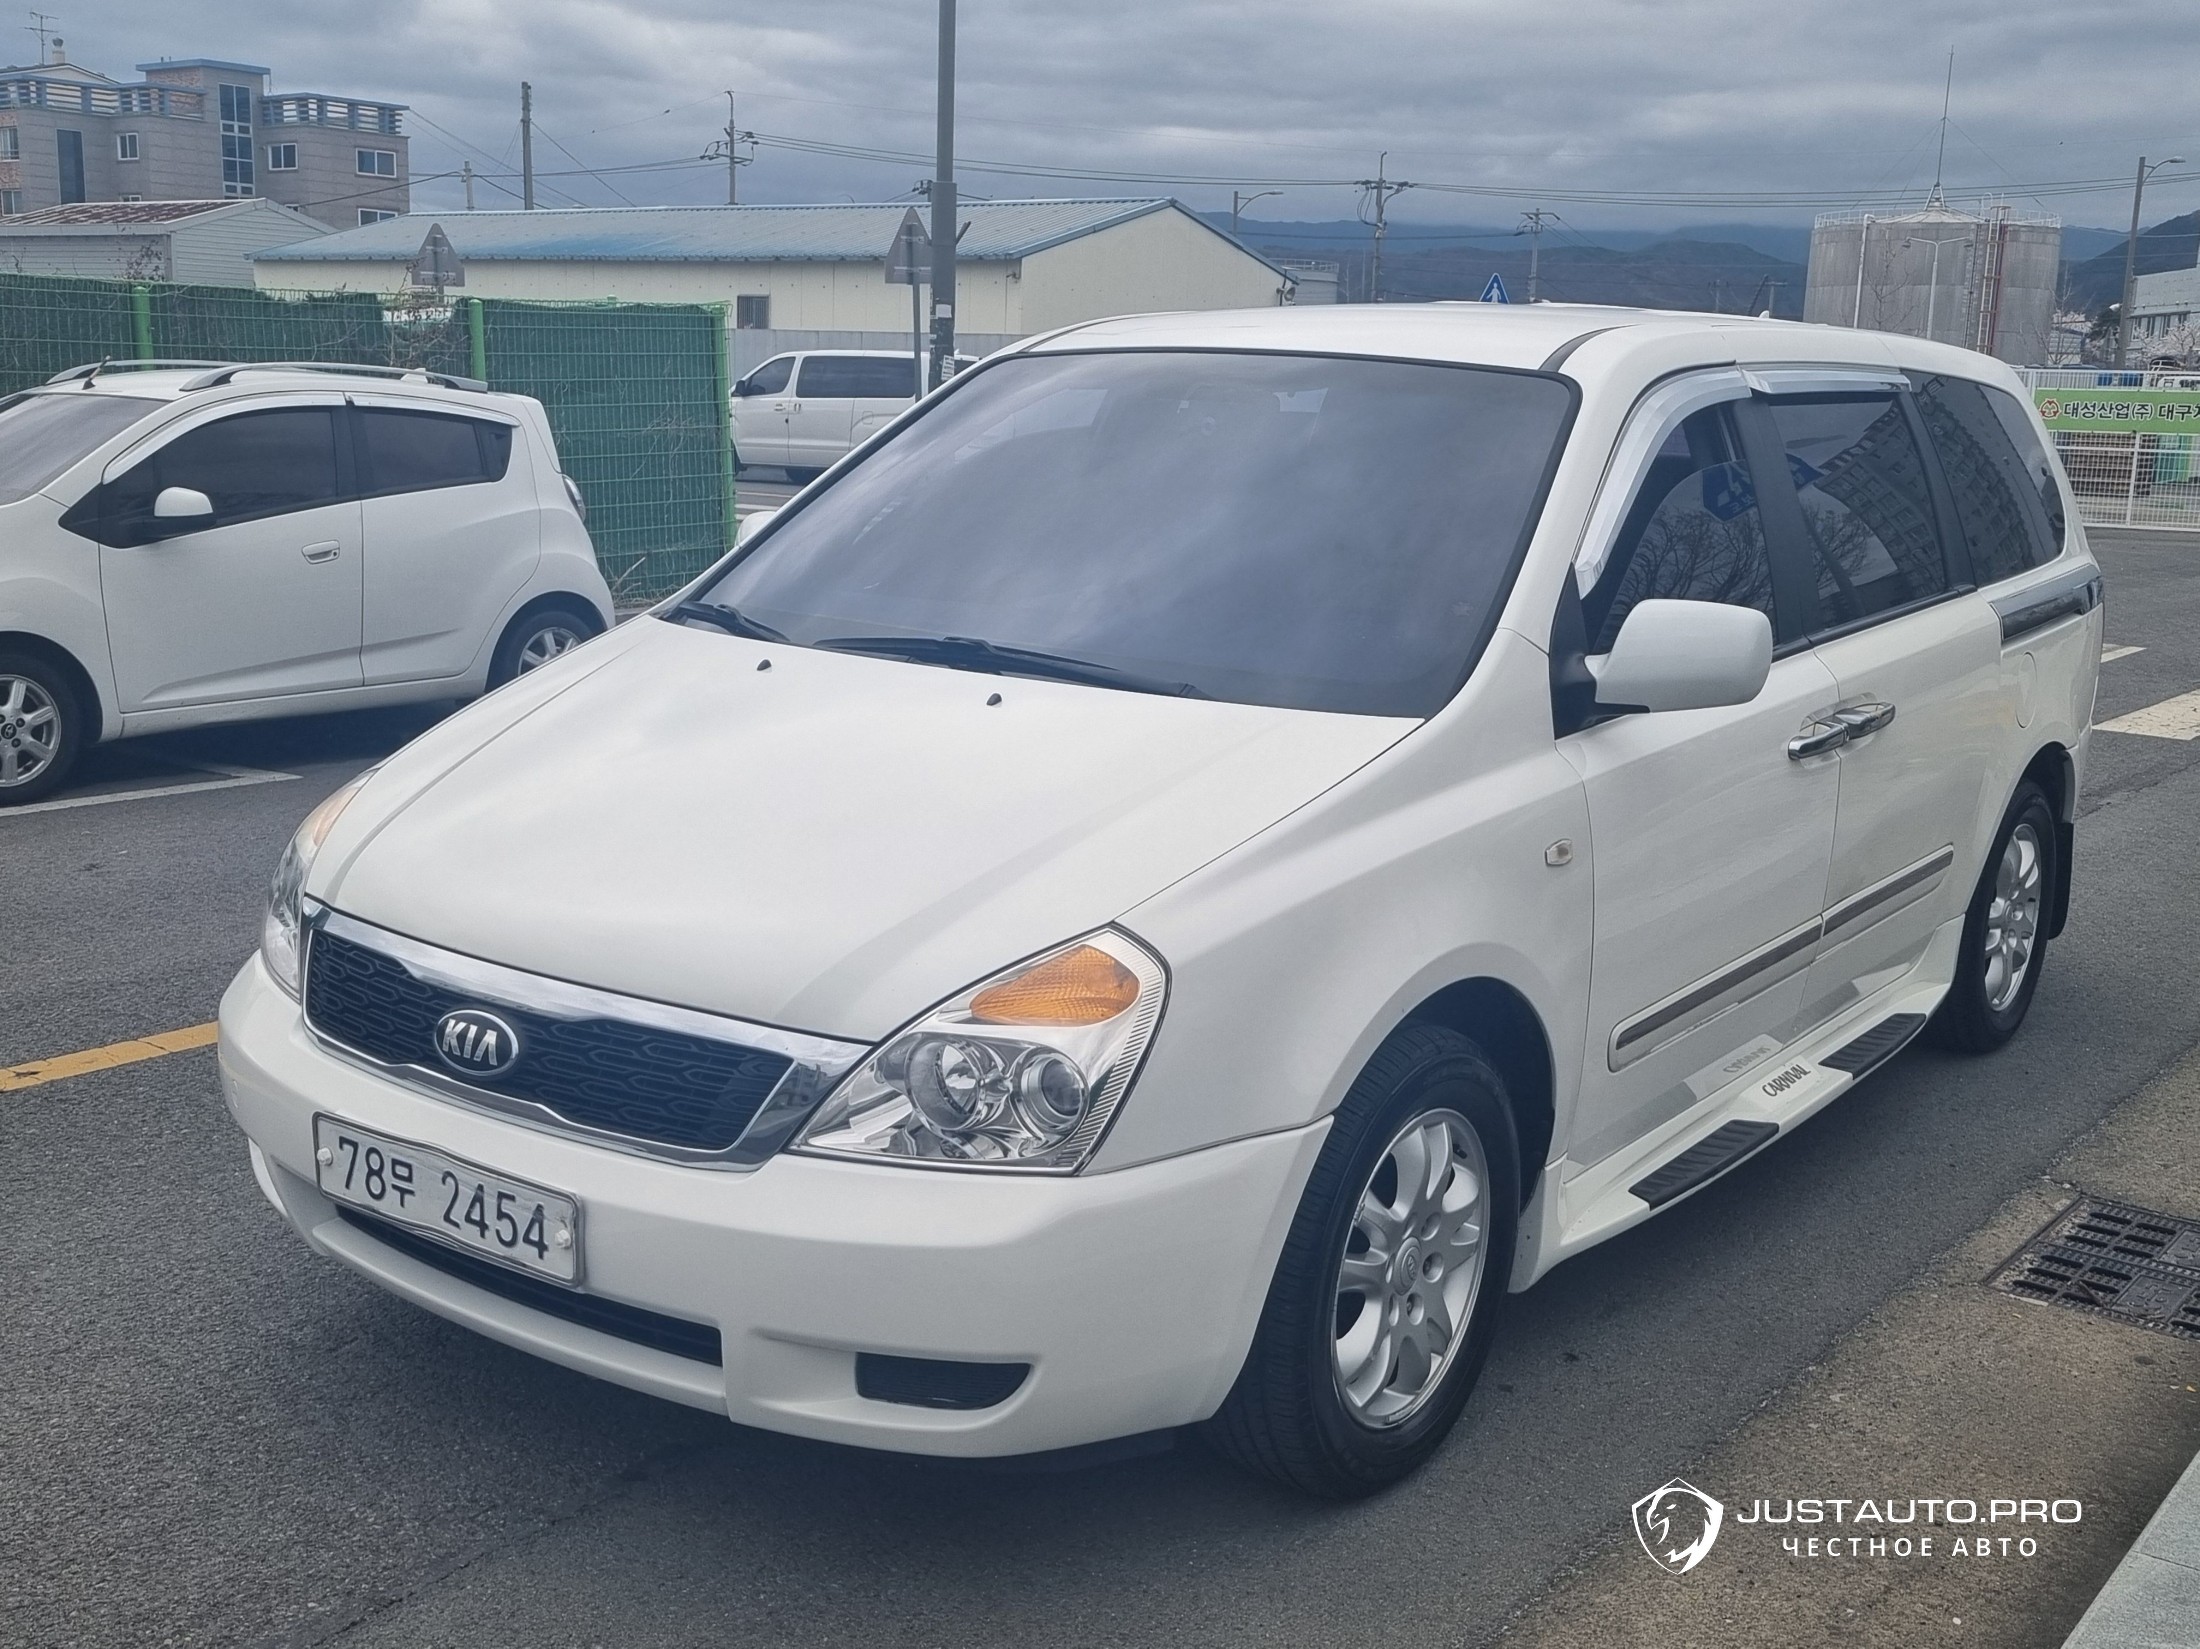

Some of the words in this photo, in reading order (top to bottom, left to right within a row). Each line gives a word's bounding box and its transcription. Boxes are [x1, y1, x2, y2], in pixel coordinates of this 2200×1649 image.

[2063, 402, 2154, 420] 대성산업(주)
[442, 1018, 498, 1067] KIA
[1761, 1063, 1812, 1098] CARNIVAL
[338, 1135, 416, 1209] 78무
[441, 1170, 549, 1260] 2454
